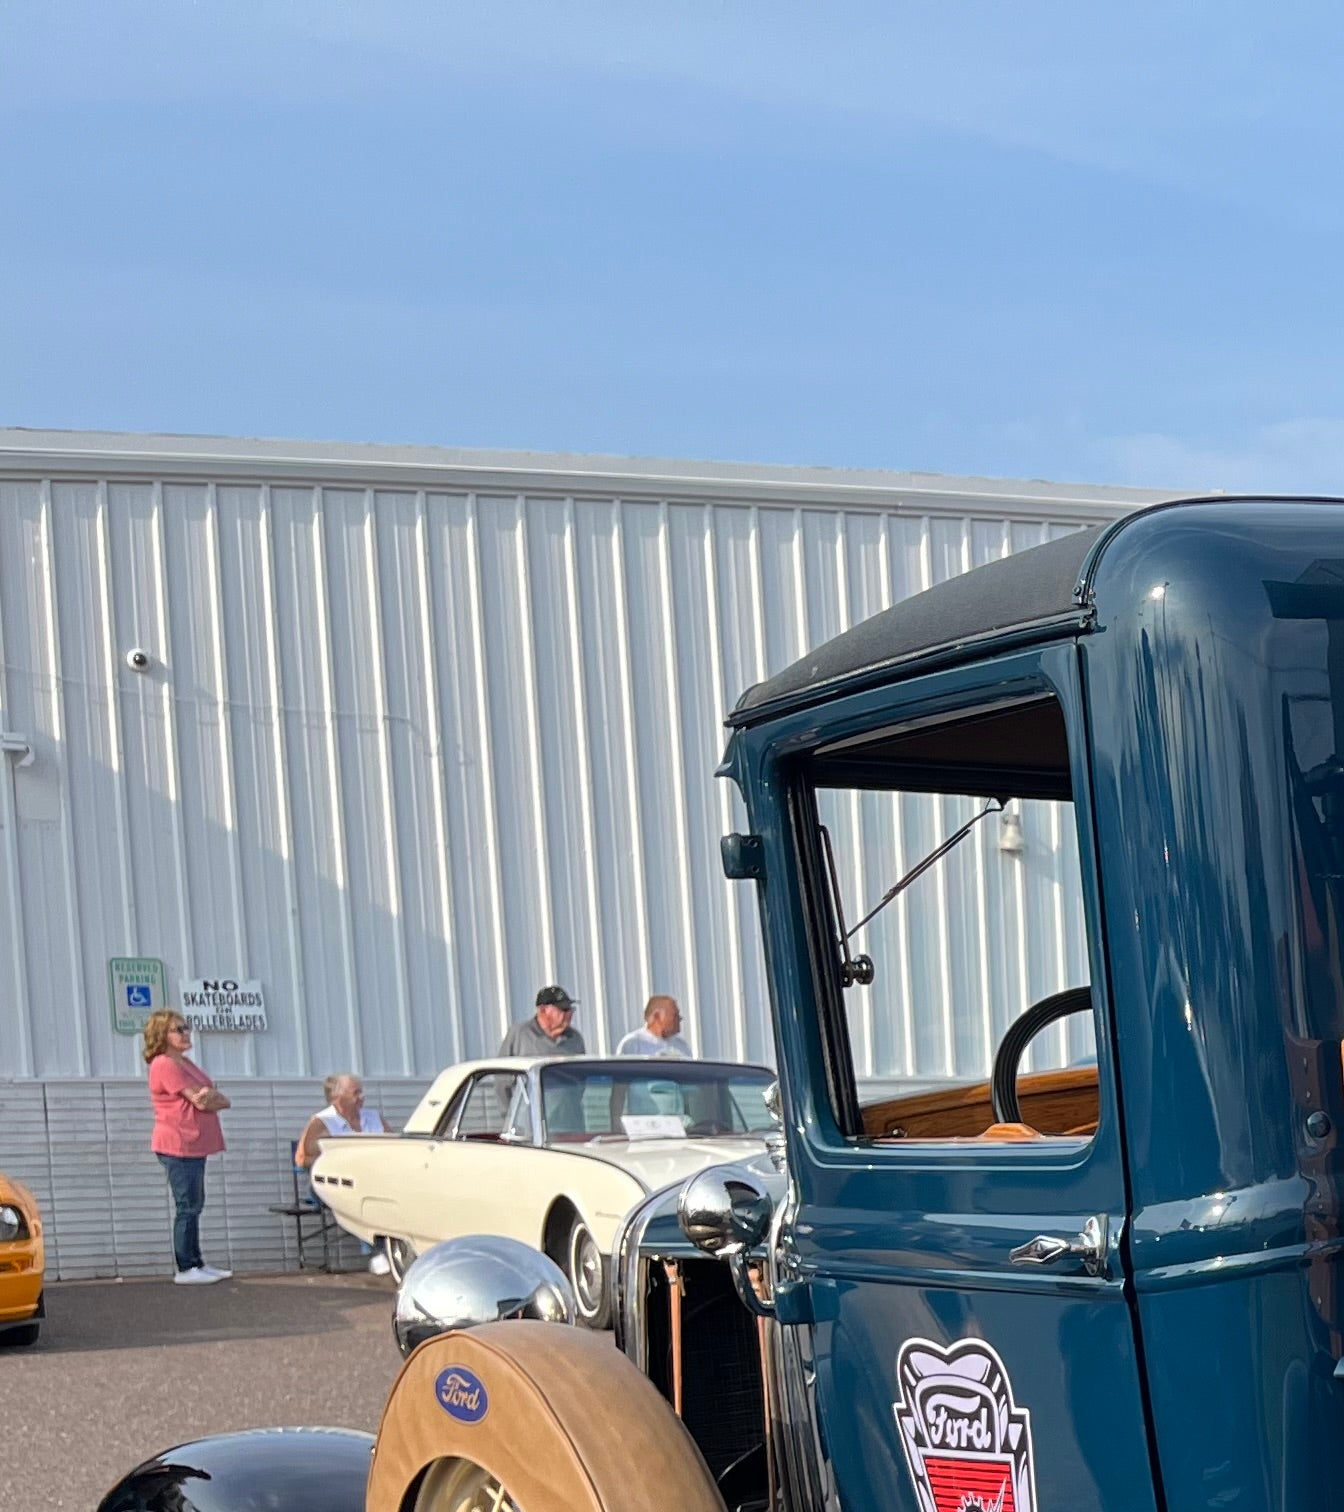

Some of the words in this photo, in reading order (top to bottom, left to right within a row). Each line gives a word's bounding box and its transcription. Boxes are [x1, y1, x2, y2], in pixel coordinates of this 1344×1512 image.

[115, 962, 159, 973] RESERVED
[119, 974, 156, 984] PARKING
[203, 980, 239, 991] NO
[183, 991, 263, 1008] SKATEBOARDS
[442, 1373, 480, 1411] Ford
[926, 1392, 991, 1449] Ford
